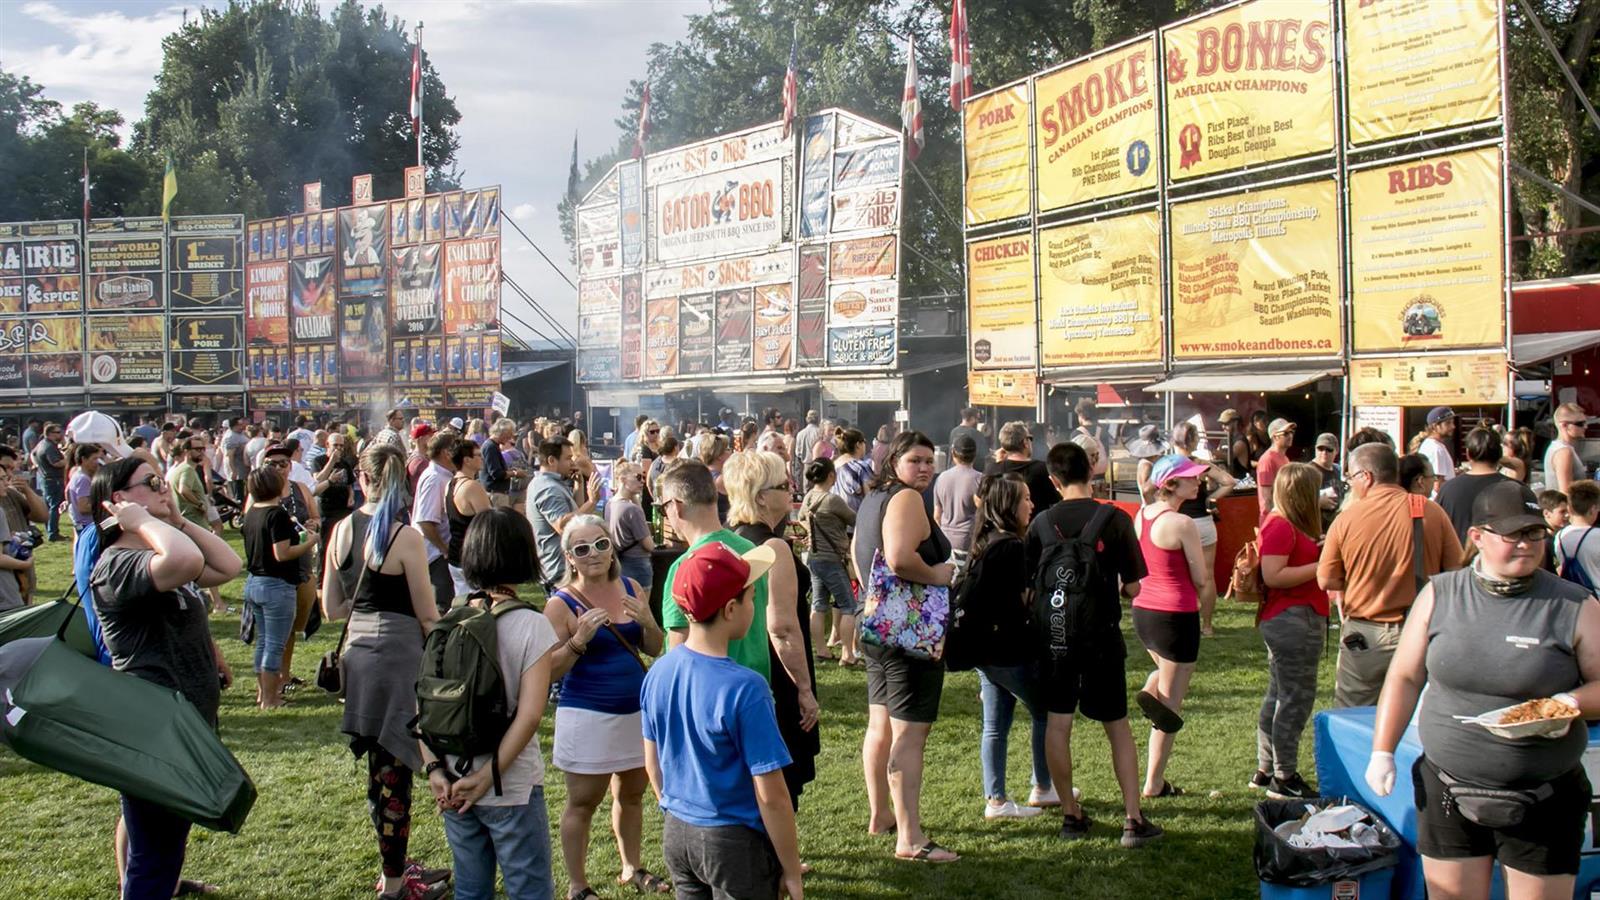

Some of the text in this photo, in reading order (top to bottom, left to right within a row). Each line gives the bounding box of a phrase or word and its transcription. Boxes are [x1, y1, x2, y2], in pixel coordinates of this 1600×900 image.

[1196, 18, 1329, 77] BONES
[1041, 50, 1149, 149] SMOKE
[1174, 80, 1308, 100] AMERICAN CHAMPIONS
[978, 104, 1016, 130] PORK
[1208, 116, 1250, 134] First Place
[1048, 100, 1153, 164] CANADIAN CHAMPIONS
[1208, 119, 1293, 146] Ribs Best of the Best
[1244, 137, 1276, 153] Georgia
[1084, 158, 1120, 175] Champions
[1388, 160, 1454, 194] RIBS
[662, 192, 711, 236] GATOR
[738, 180, 774, 221] BBQ
[118, 242, 160, 252] WORLD
[974, 240, 1030, 262] CHICKEN
[1253, 280, 1276, 292] Award
[1277, 272, 1308, 289] Winning
[42, 291, 79, 302] SPICE
[1264, 282, 1331, 303] Pike Place Market
[396, 304, 436, 320] OVERALL
[1254, 302, 1270, 314] BBQ
[1259, 306, 1332, 326] Seattle Washington
[832, 335, 891, 352] GLUTEN FREE
[1180, 338, 1332, 352] www.smokeandbones.ca
[49, 370, 80, 378] Canada
